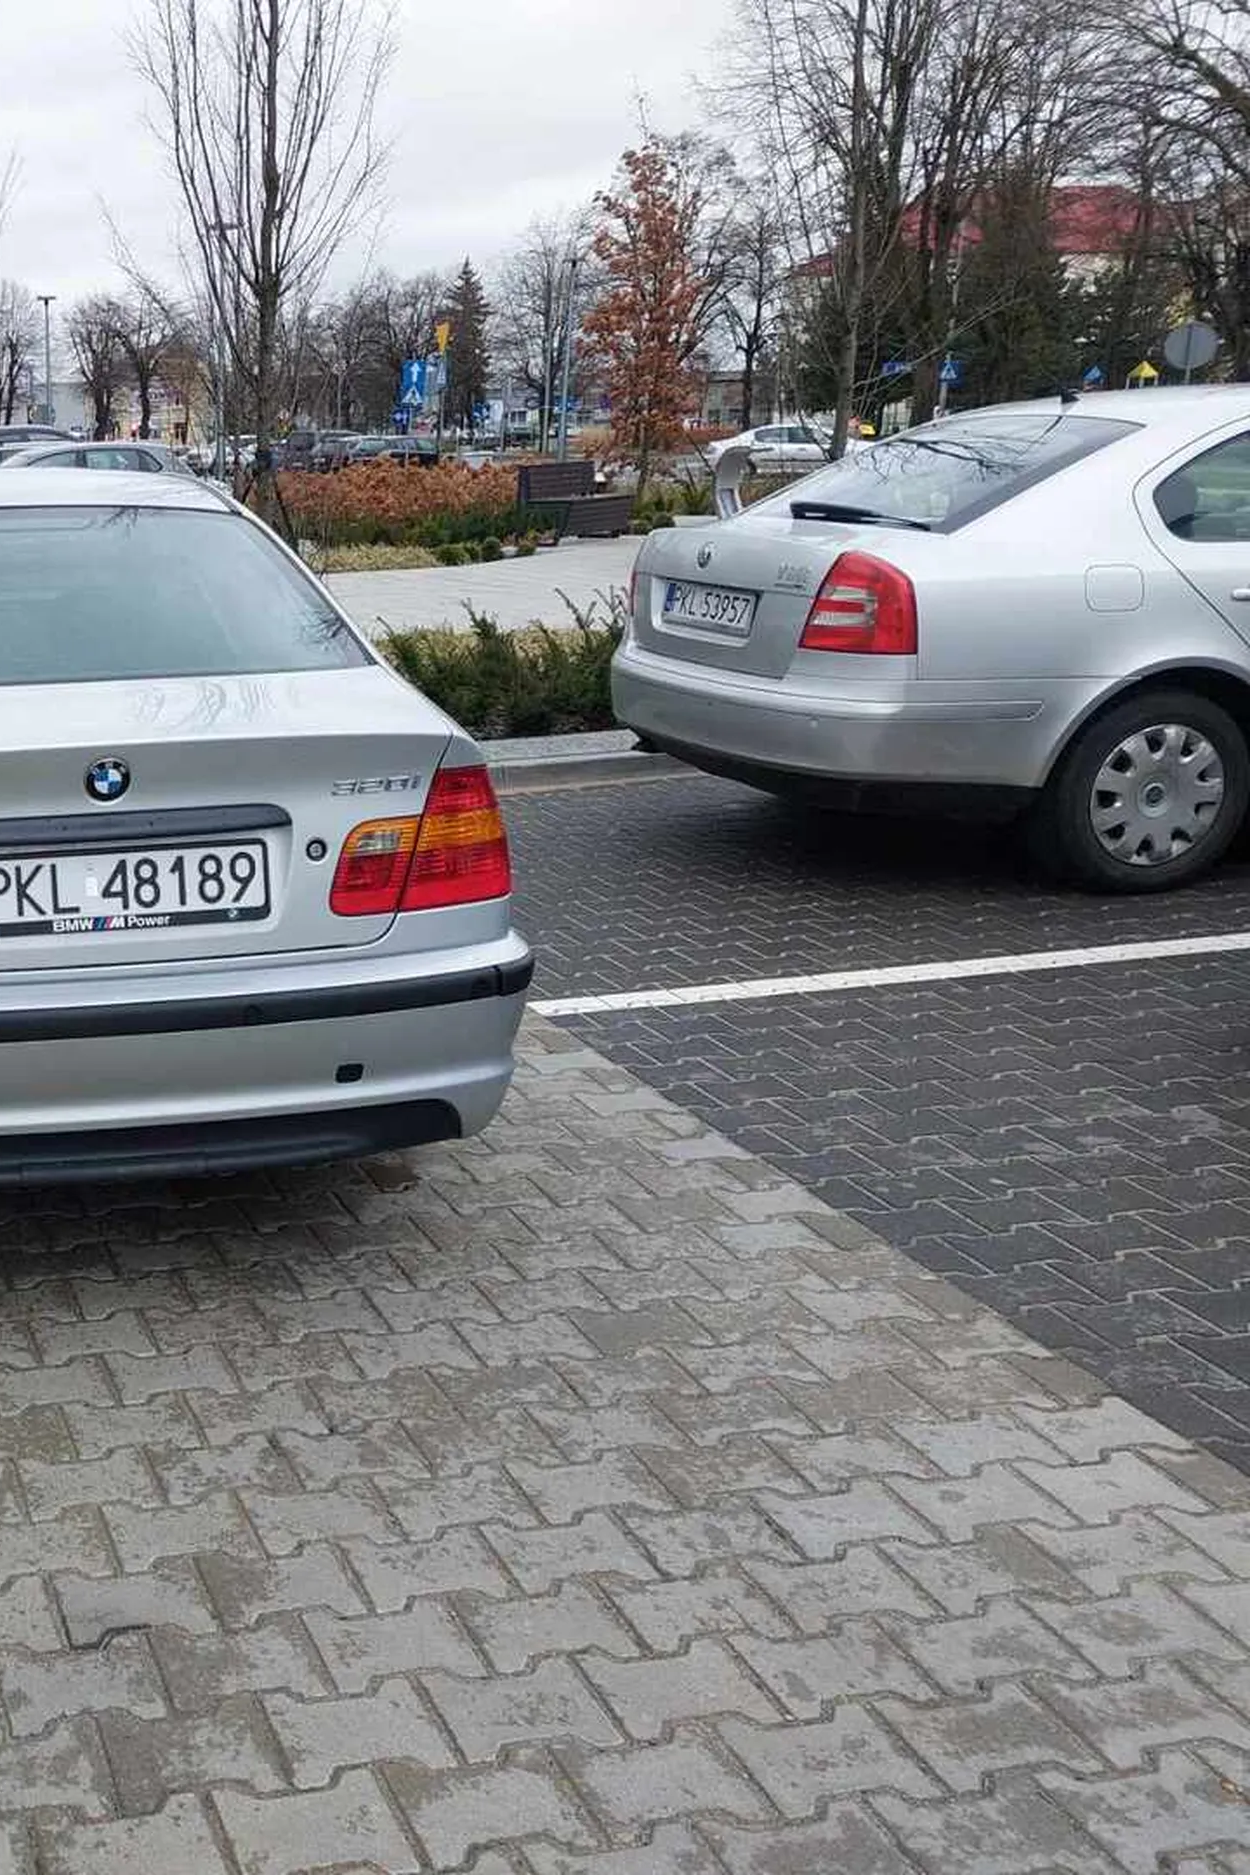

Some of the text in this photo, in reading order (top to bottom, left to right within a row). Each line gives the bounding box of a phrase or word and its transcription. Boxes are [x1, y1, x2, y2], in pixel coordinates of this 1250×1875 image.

[676, 584, 750, 624] PKL 53957
[331, 773, 422, 796] 320i
[101, 852, 256, 912] 48189
[53, 918, 93, 932] BMW
[128, 915, 170, 927] Power
